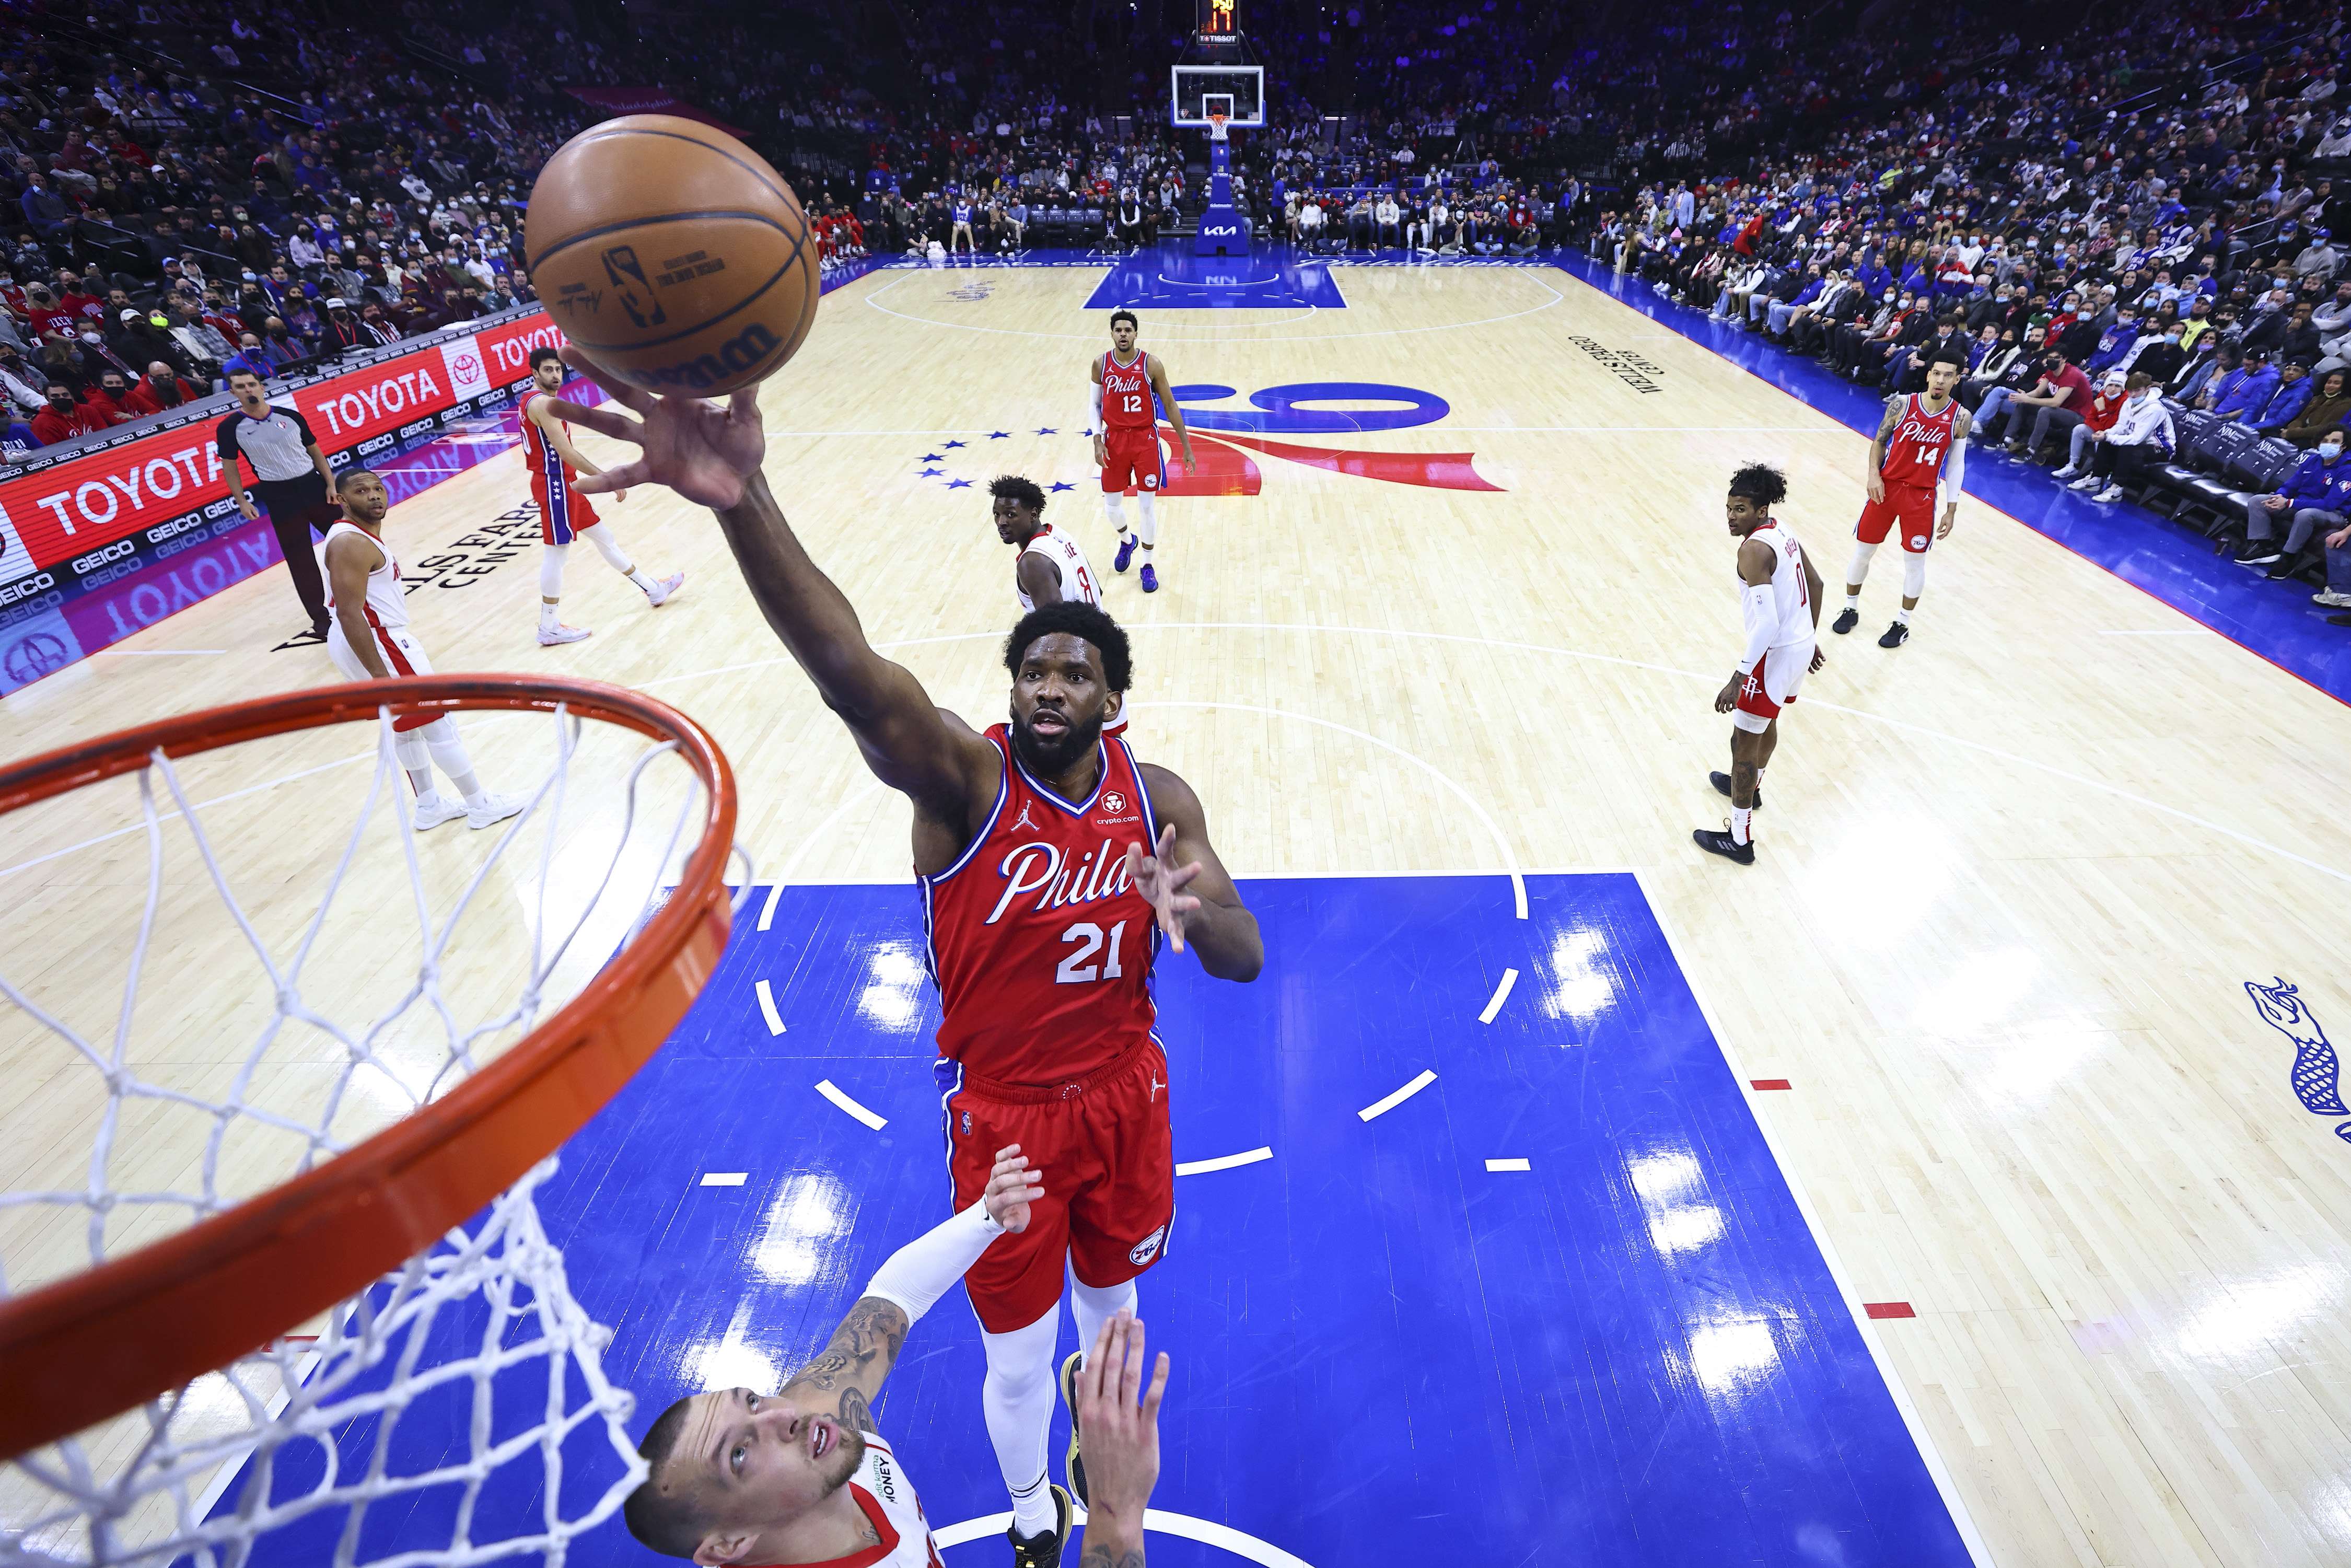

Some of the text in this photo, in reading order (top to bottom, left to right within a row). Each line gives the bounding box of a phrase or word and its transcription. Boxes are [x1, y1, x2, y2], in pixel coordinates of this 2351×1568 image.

[1213, 10, 1230, 31] 17
[1293, 258, 1554, 267] Philadelphia
[1568, 336, 1663, 393] WELLS FARGO
[1616, 350, 1665, 375] CENTER
[1105, 375, 1142, 395] Phila
[27, 458, 53, 471] GEICO
[55, 450, 81, 462] GEICO
[84, 442, 109, 453] GEICO
[111, 434, 134, 445] GEICO
[136, 425, 158, 437] GEICO
[164, 418, 185, 429] GEICO
[188, 411, 208, 421] GEICO
[210, 404, 229, 414] GEICO
[270, 386, 287, 396] GEICO
[289, 380, 307, 389] GEICO
[307, 374, 324, 384] GEICO
[325, 369, 340, 378] GEICO
[342, 364, 357, 373] GEICO
[358, 359, 373, 367] GEICO
[375, 353, 389, 362] GEICO
[316, 368, 441, 435] TOYOTA
[1123, 395, 1142, 412] 12
[2183, 412, 2199, 424] NJM
[1898, 421, 1946, 444] Phila
[2219, 425, 2237, 438] NJM
[1915, 445, 1939, 467] 14
[2256, 440, 2275, 454] NJM
[2296, 452, 2310, 464] NJ
[0, 572, 55, 608] EICO
[72, 540, 135, 575] GEICO
[146, 512, 202, 544] GEICO
[327, 450, 351, 469] ICO
[357, 433, 394, 456] GEICO
[400, 417, 434, 438] GEICO
[441, 402, 471, 422] GEICO
[479, 388, 506, 406] GEICO
[37, 440, 224, 536] TOYOTA
[438, 522, 543, 588] CENTE
[1077, 566, 1096, 605] 8
[1796, 562, 1807, 608] 0
[1097, 815, 1139, 825] crypto.com
[983, 838, 1133, 925] Phila
[1055, 920, 1127, 984] 21
[873, 1455, 881, 1482] karma
